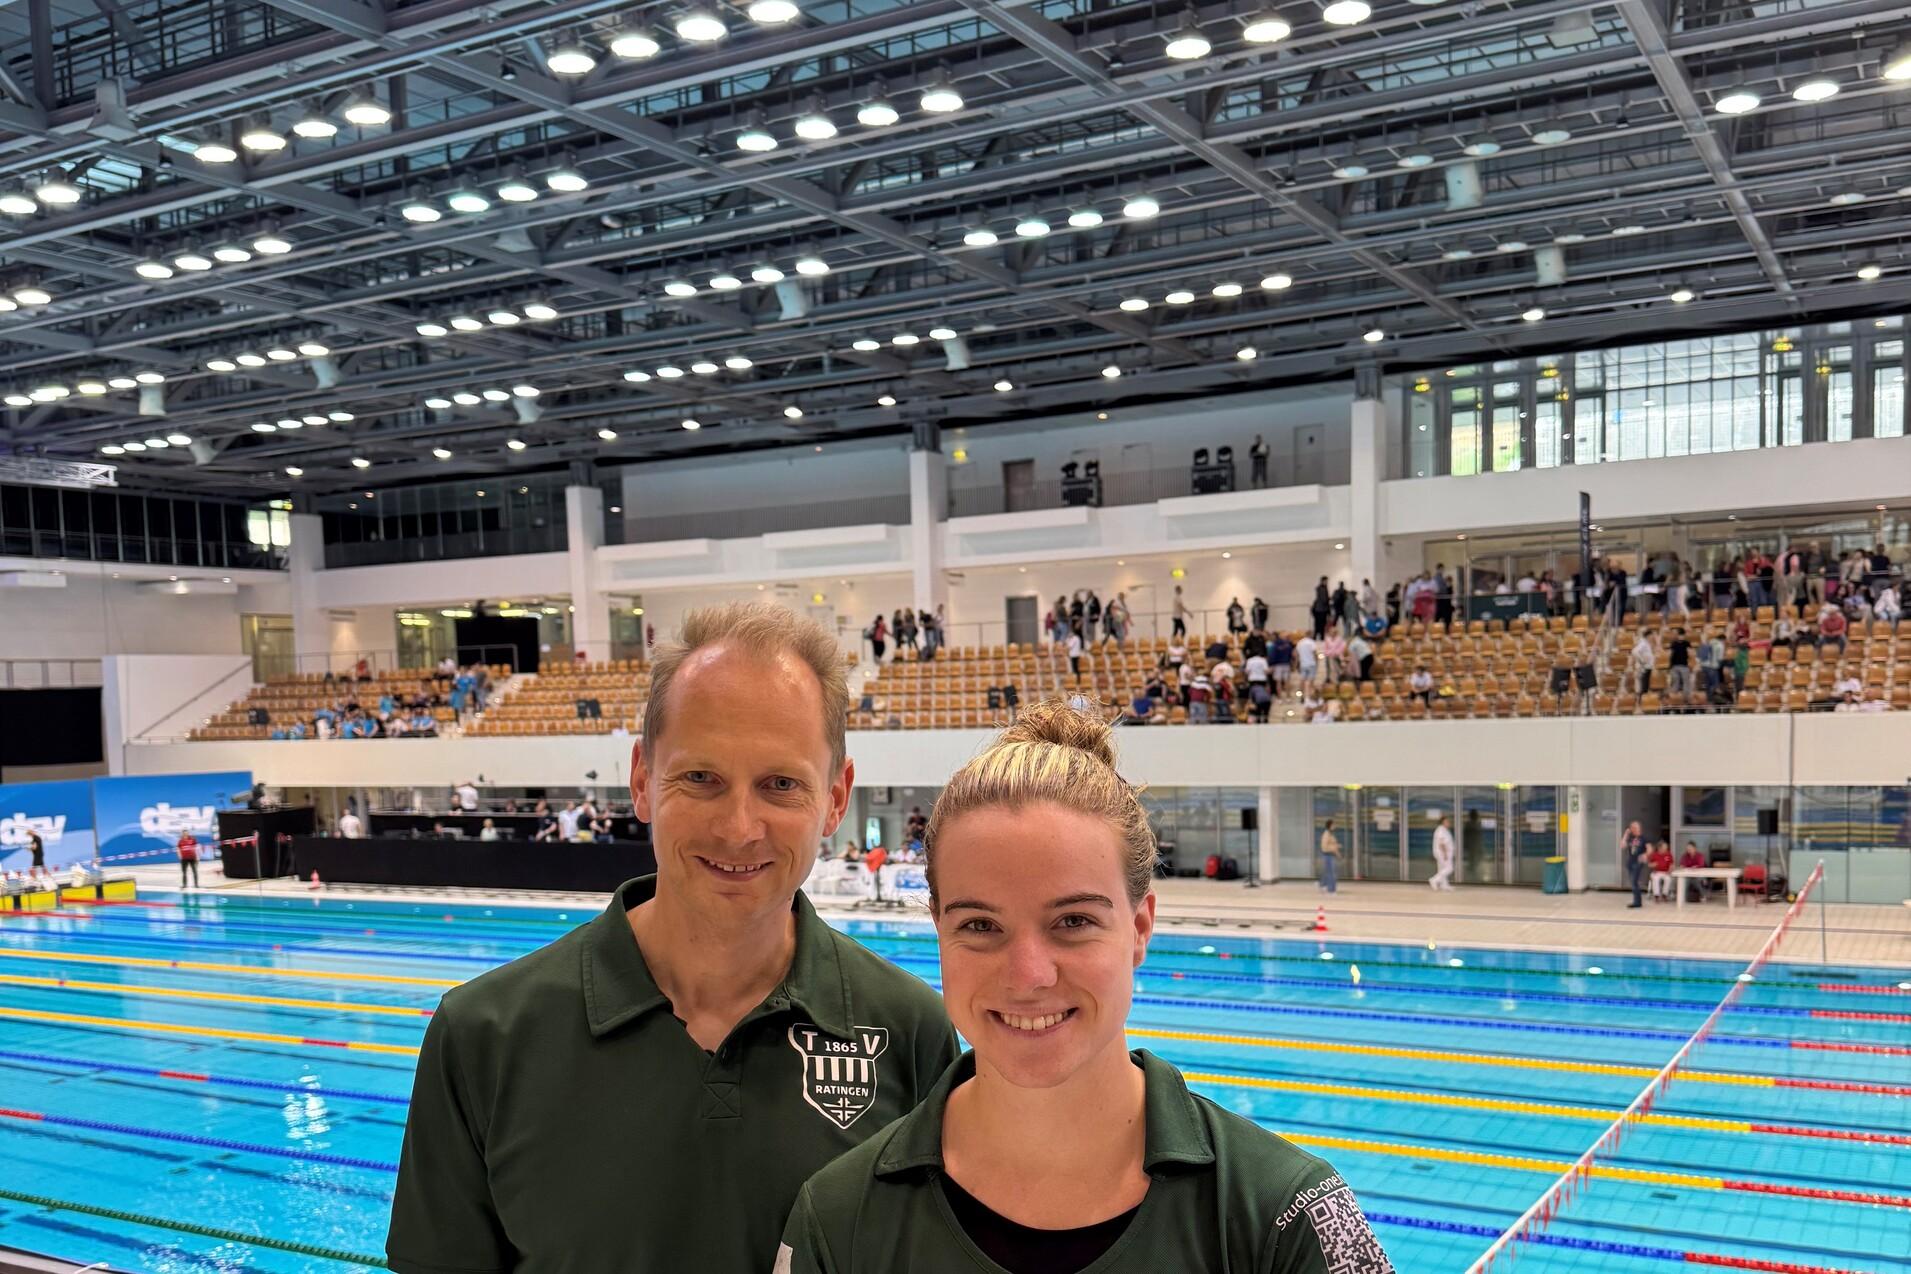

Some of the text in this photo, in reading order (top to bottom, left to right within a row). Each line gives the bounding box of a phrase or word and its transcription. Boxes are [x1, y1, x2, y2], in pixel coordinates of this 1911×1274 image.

[802, 1031, 880, 1055] T 1865 V
[815, 1084, 869, 1097] RATINGEN
